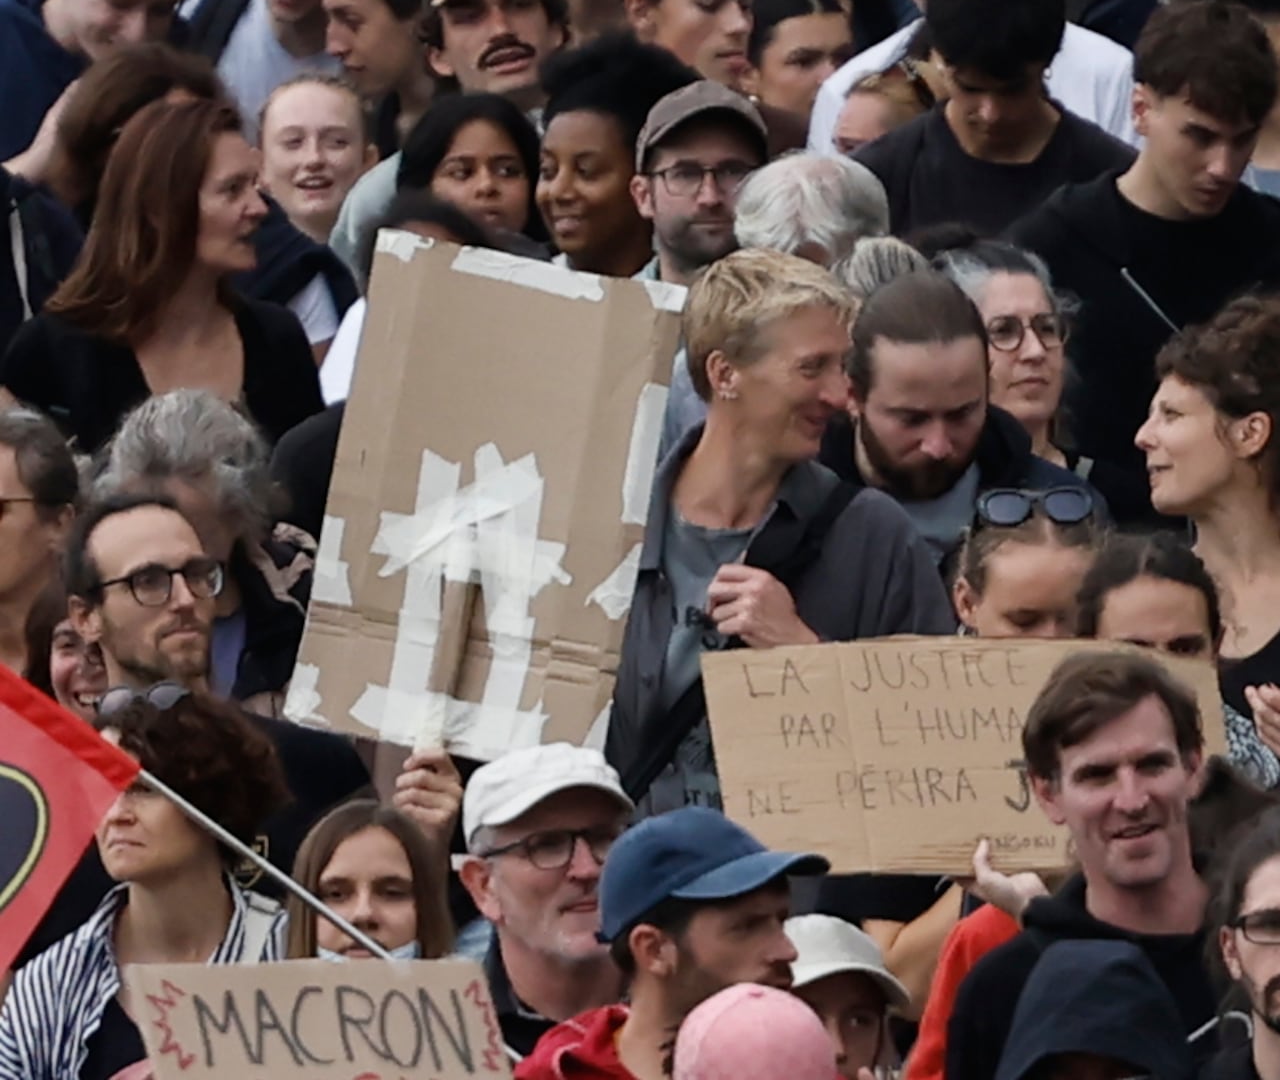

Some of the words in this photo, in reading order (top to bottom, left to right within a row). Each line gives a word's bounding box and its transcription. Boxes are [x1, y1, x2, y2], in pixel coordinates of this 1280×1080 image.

[741, 657, 810, 700] LA
[849, 647, 1028, 693] JUSTICE
[779, 711, 849, 751] PAR
[873, 701, 1025, 748] L'HUMA
[747, 781, 802, 819] NE
[836, 764, 978, 812] PÉRIRA
[192, 984, 476, 1075] MACRON
